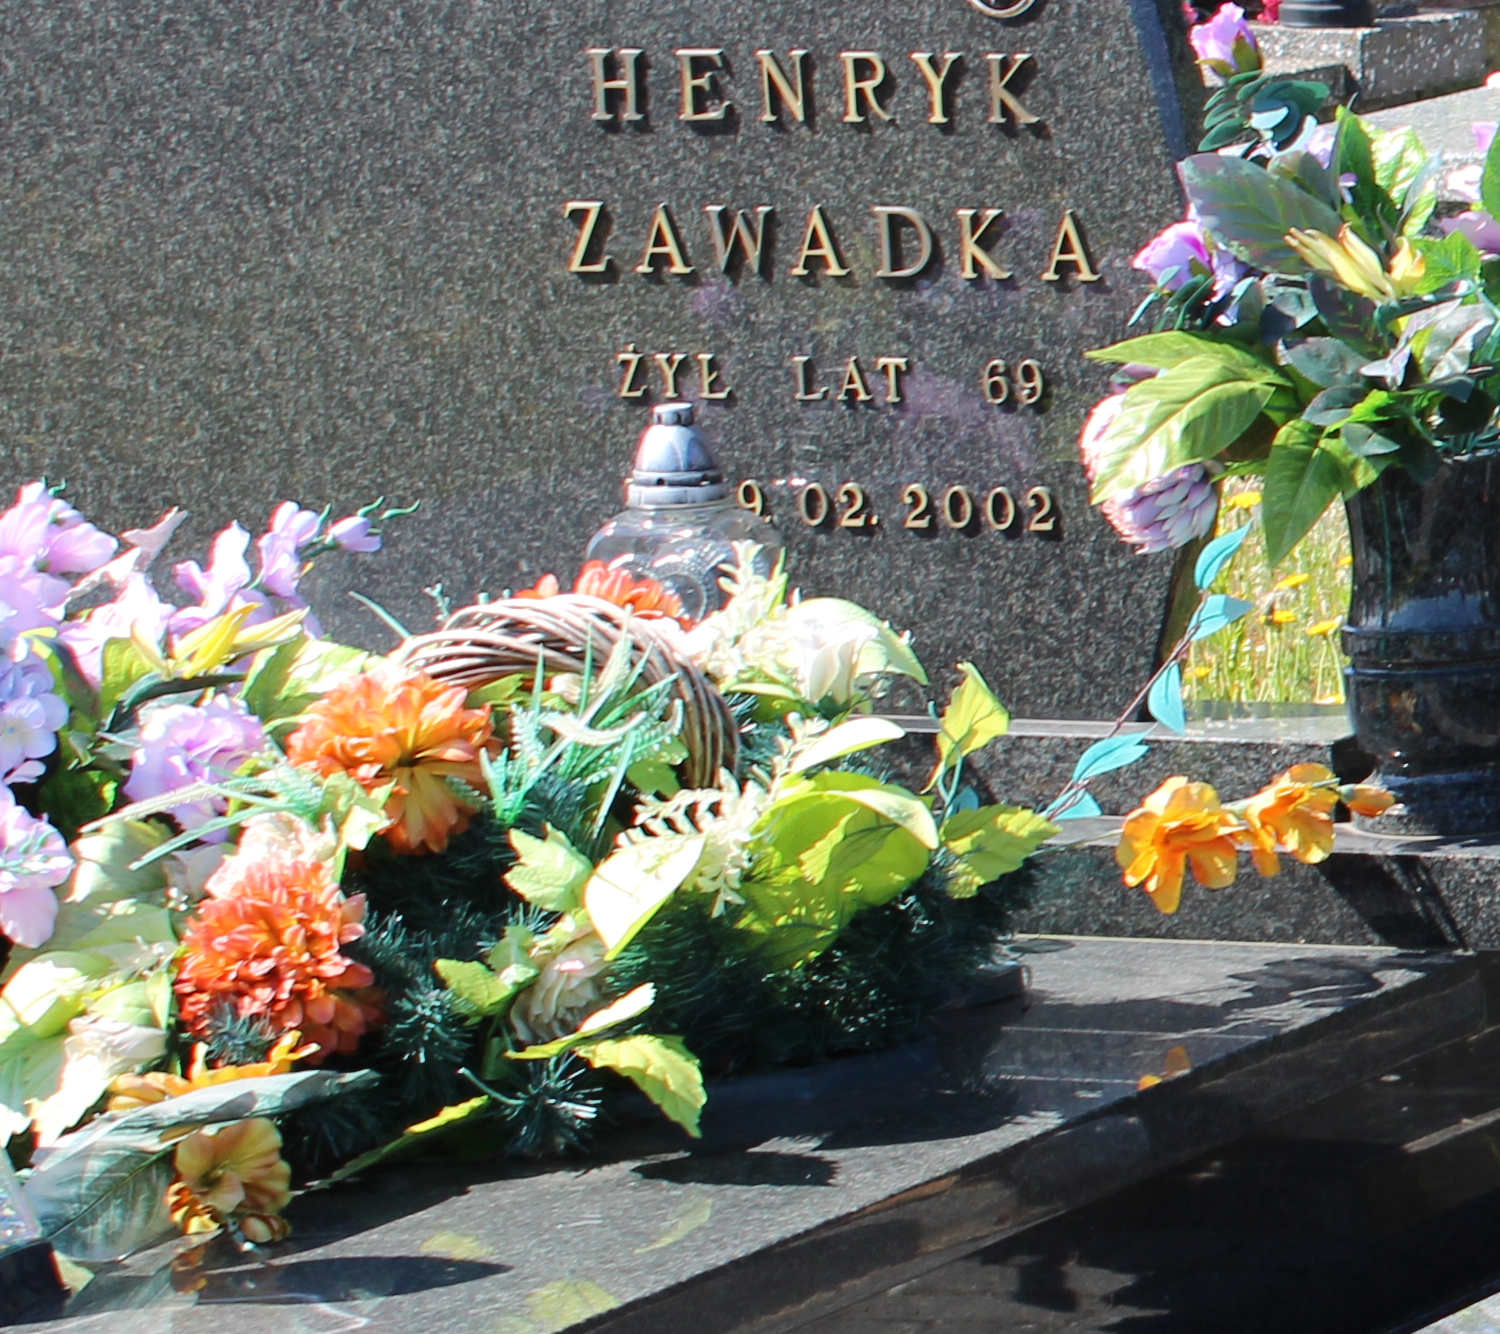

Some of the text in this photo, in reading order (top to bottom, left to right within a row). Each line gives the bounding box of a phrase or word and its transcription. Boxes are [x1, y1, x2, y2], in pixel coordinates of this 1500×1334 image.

[586, 47, 1041, 126] HENRYK
[563, 200, 1101, 283] ZAWADKA
[616, 343, 1044, 405] ŻYŁ LAT 69
